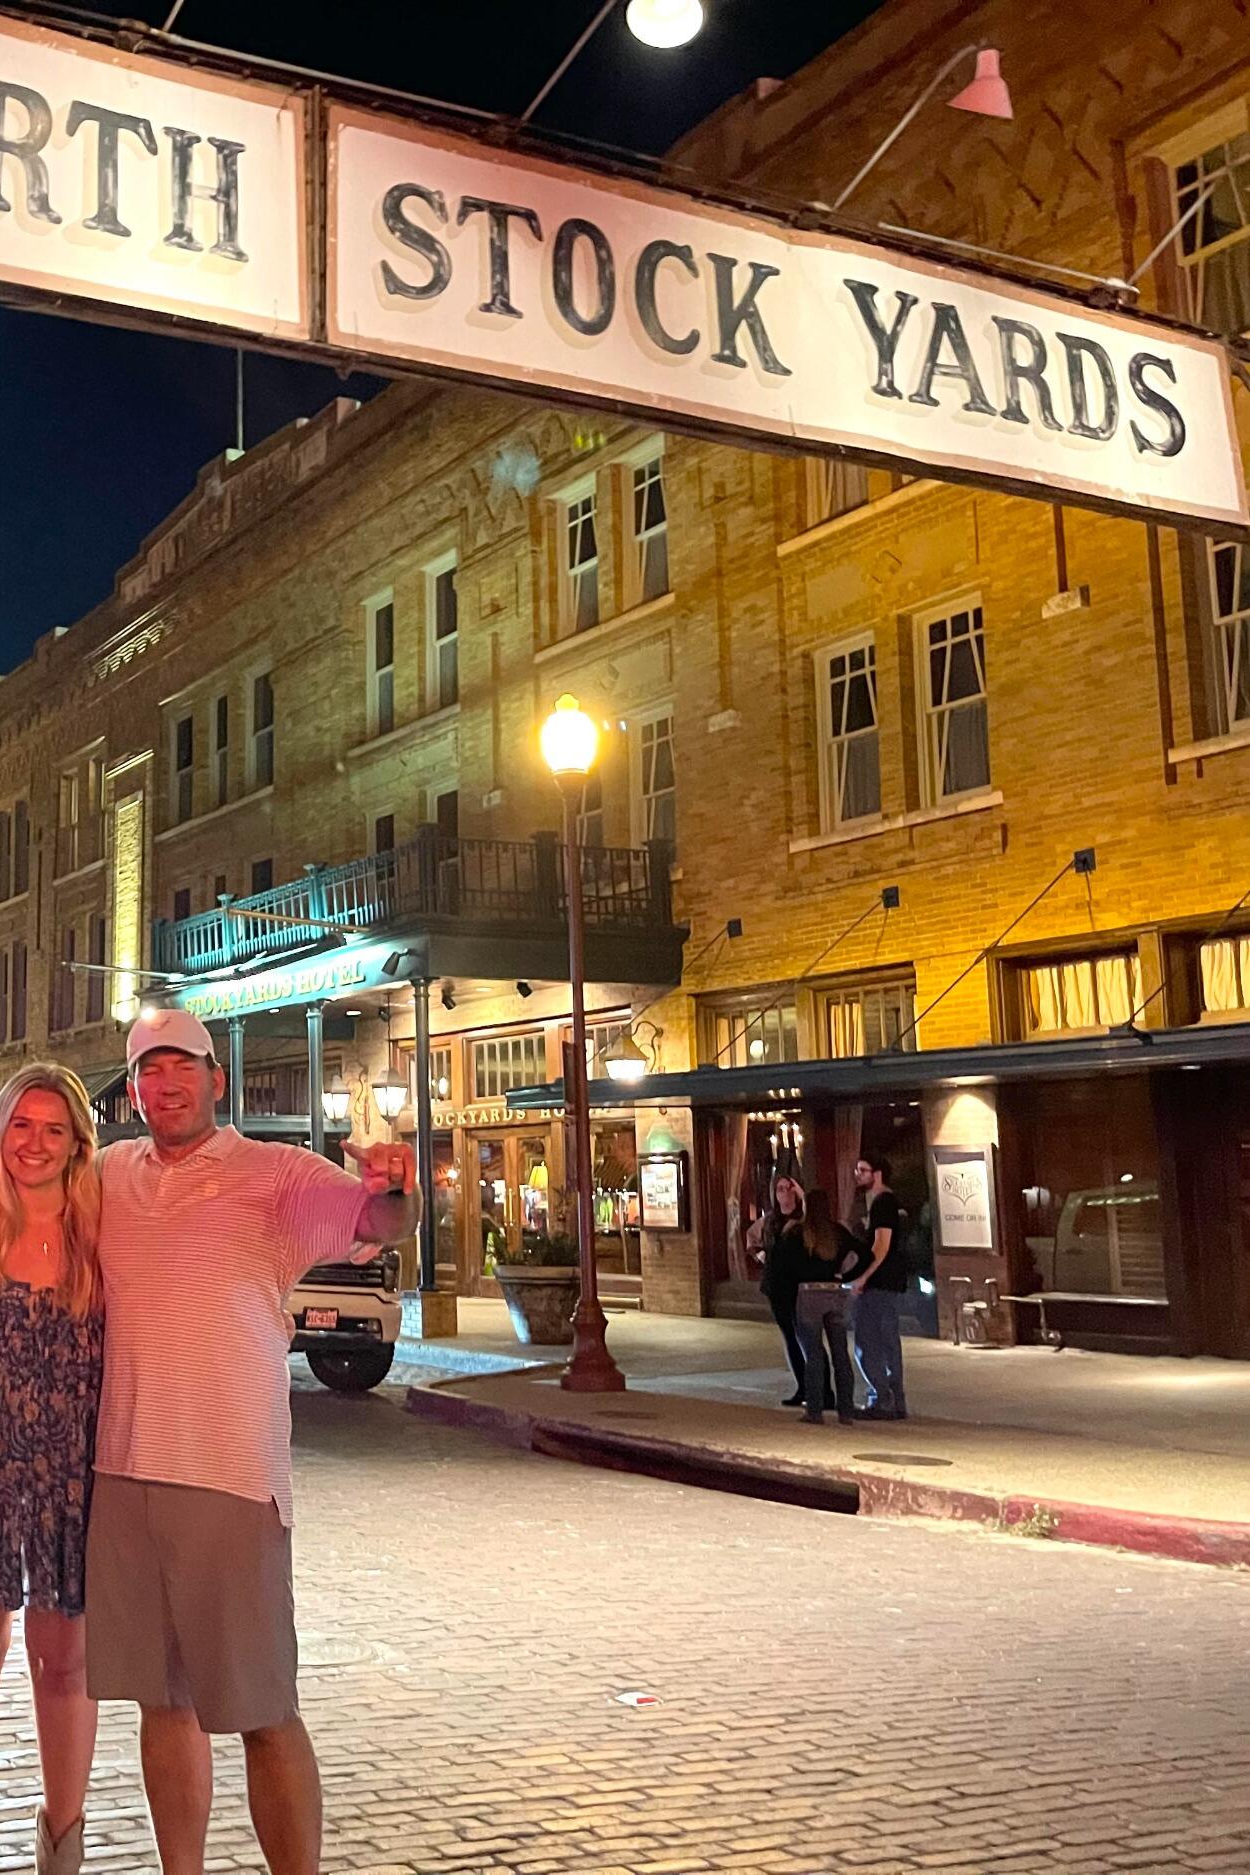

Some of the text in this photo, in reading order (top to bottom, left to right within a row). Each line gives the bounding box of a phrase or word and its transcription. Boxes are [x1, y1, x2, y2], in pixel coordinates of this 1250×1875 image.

[380, 182, 1187, 458] STOCK YARDS
[296, 960, 366, 994] HOTEL
